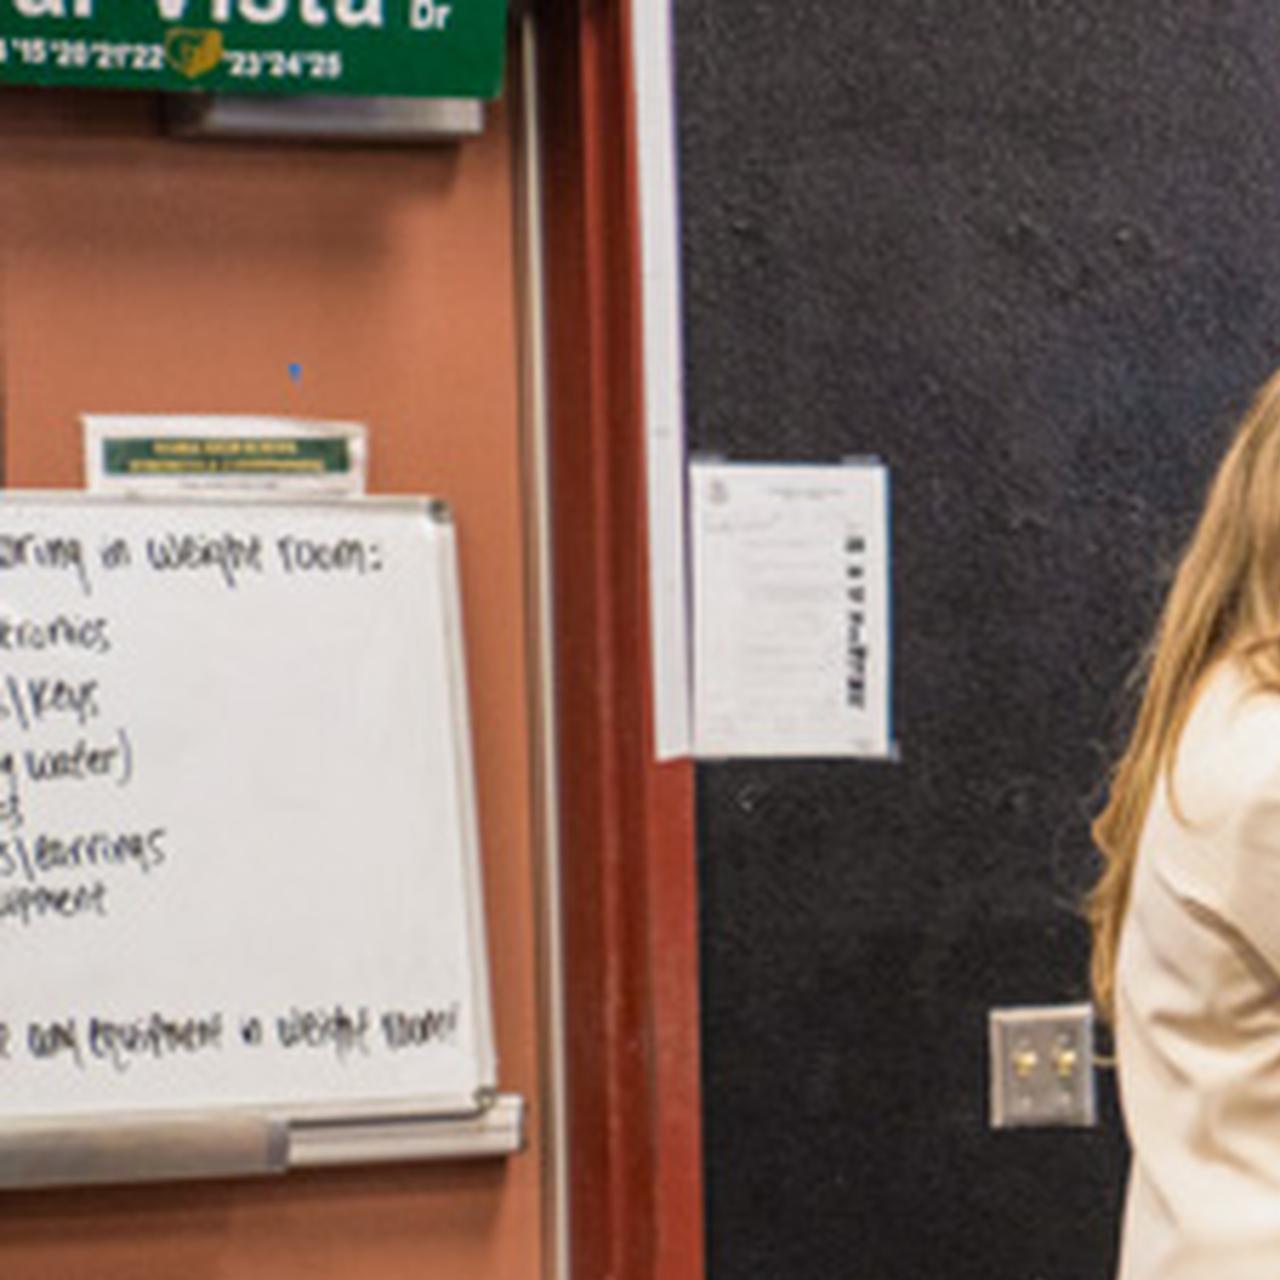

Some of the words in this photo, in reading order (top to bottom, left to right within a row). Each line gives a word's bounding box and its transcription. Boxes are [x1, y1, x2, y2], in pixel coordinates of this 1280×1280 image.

[409, 0, 452, 30] Dr
[101, 537, 131, 571] in
[146, 532, 262, 590] weight
